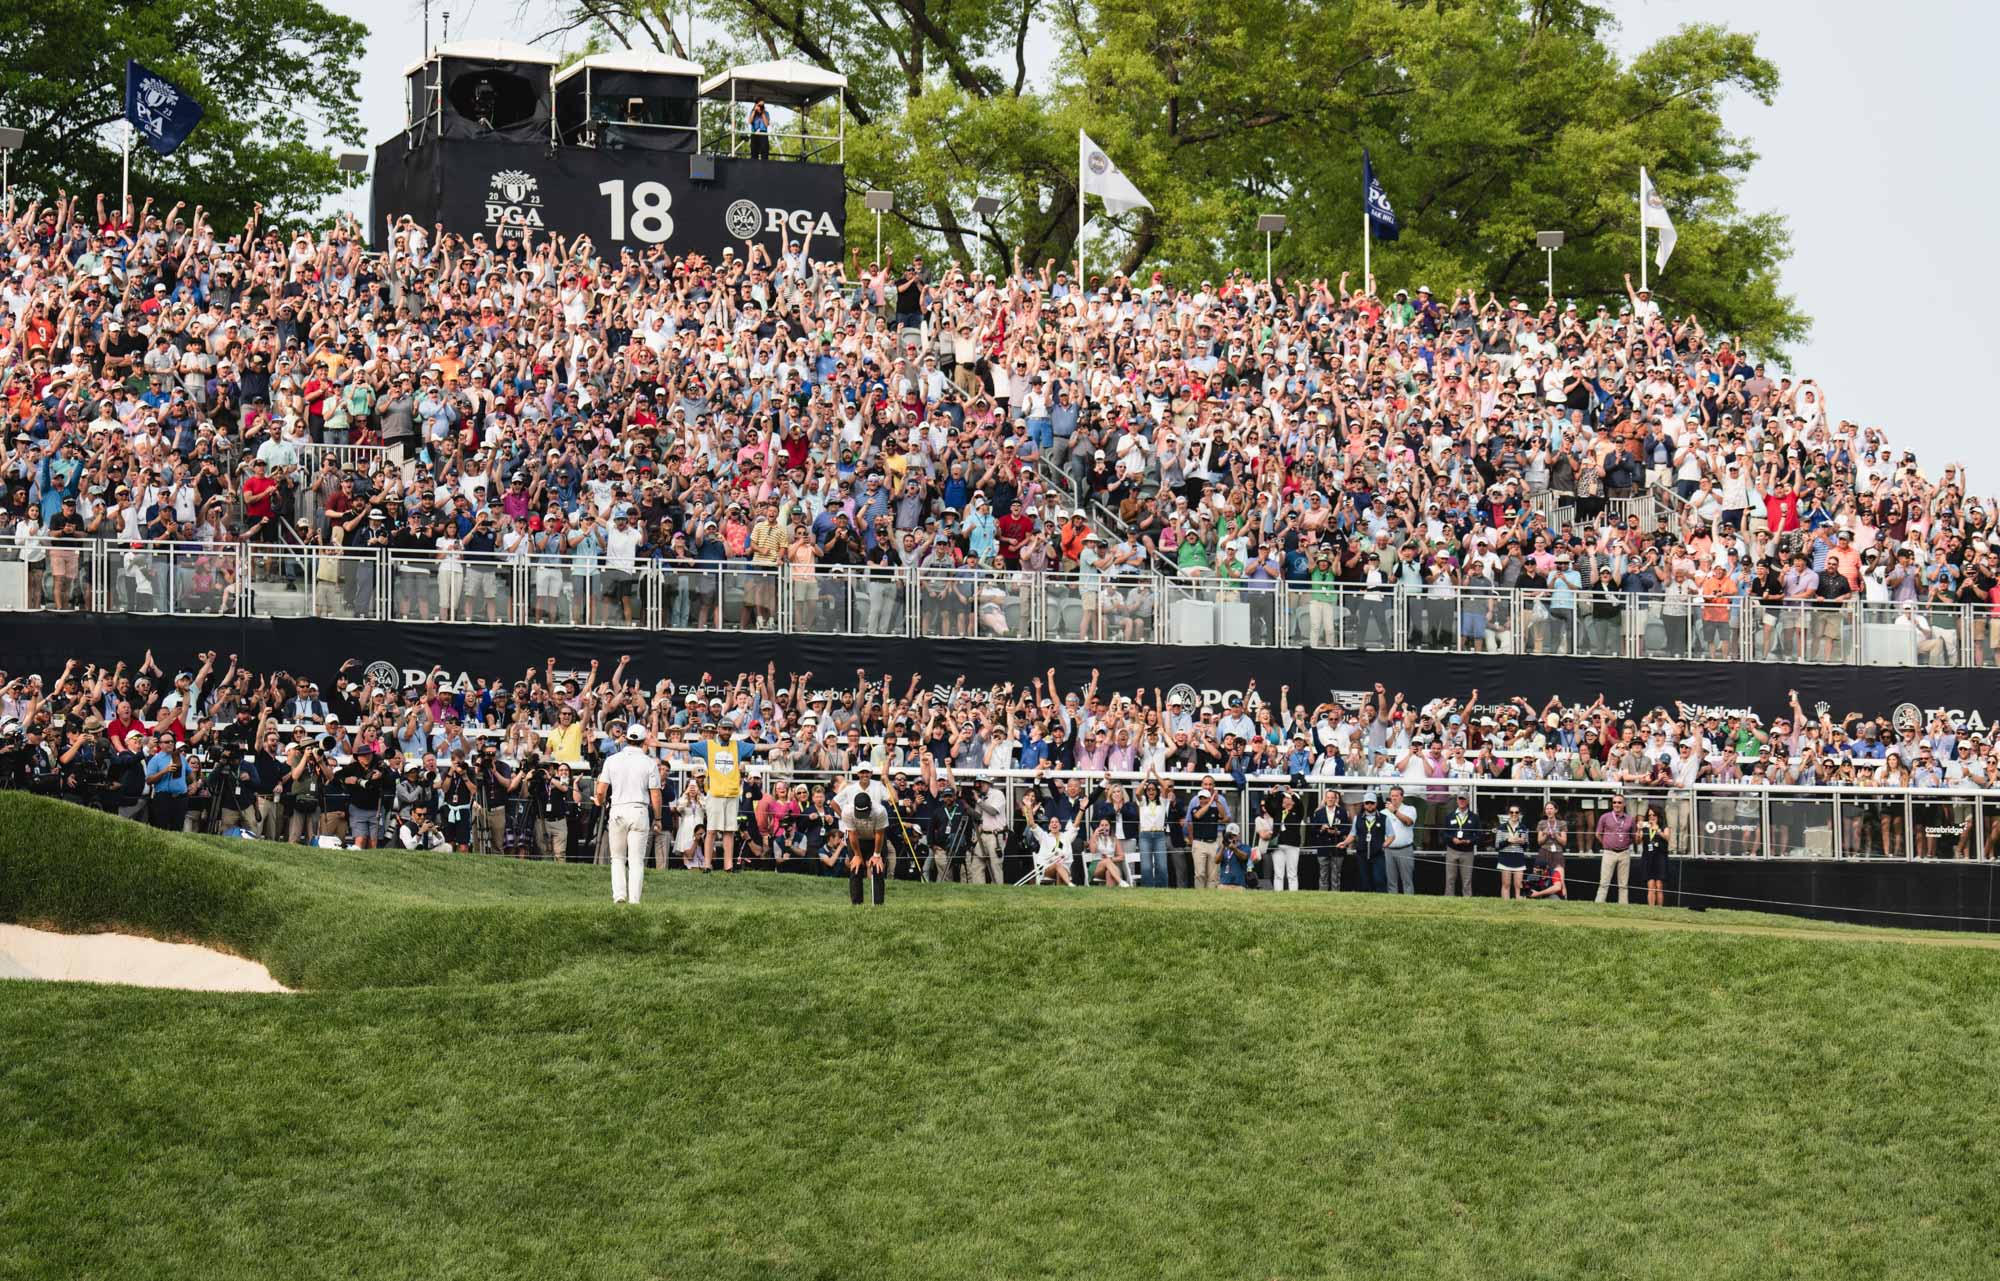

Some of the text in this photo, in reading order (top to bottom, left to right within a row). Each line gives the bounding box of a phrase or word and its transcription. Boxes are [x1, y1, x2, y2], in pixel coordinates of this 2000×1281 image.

[137, 102, 163, 136] PA
[489, 192, 540, 204] 20 23
[1368, 187, 1393, 212] PG
[485, 204, 544, 227] PGA
[599, 179, 674, 243] 18
[733, 215, 754, 224] PGA
[765, 207, 840, 237] PGA
[38, 326, 47, 342] 9
[402, 669, 475, 695] PGA
[1925, 825, 1964, 836] corebridge
